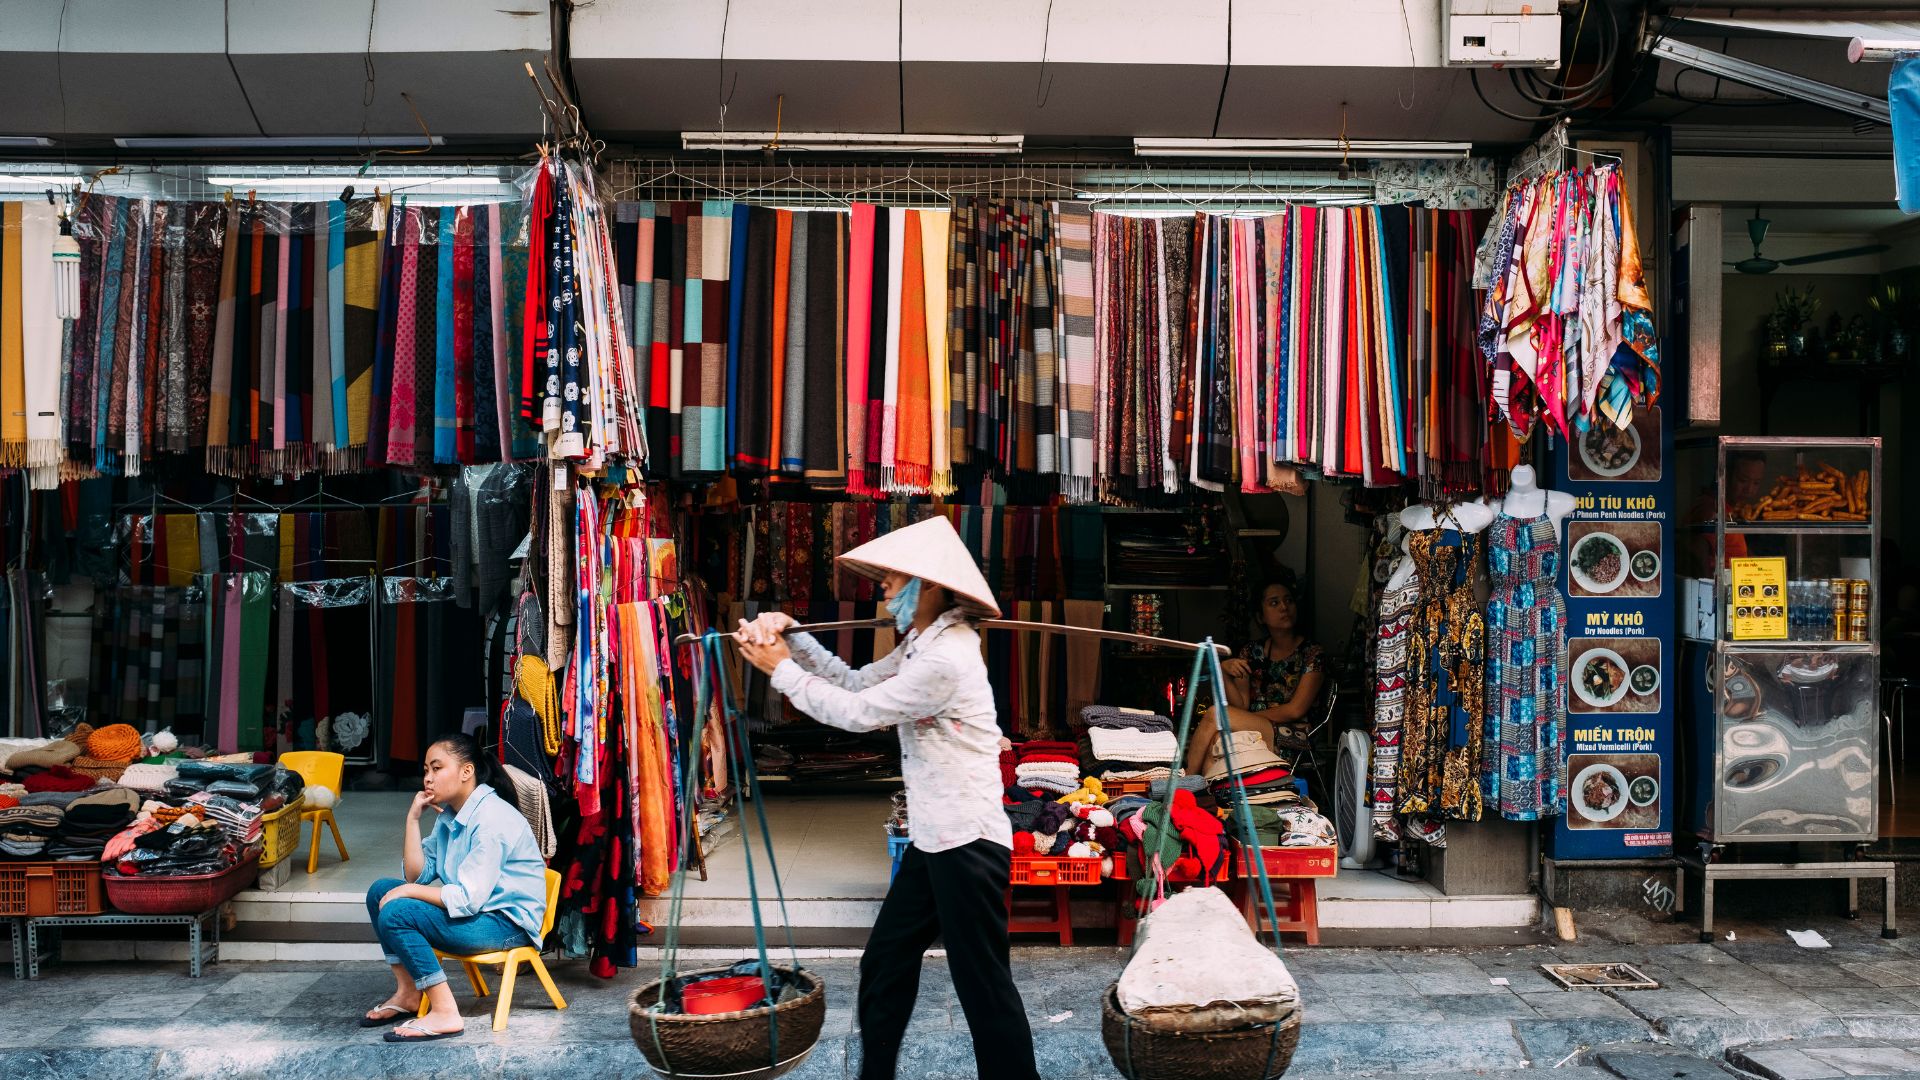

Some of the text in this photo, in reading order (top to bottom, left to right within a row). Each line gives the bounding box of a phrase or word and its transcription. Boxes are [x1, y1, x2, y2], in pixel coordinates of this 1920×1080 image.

[1599, 494, 1622, 509] TÍU
[1626, 494, 1656, 509] KHÔ
[1576, 511, 1599, 519] Phnom
[1600, 511, 1617, 519] Penh
[1618, 511, 1645, 519] Noodles
[1646, 511, 1666, 519] (Pork)
[1614, 611, 1643, 625] KHÔ
[1585, 627, 1645, 635] Dry Noodles (Pork)
[1617, 726, 1655, 744] TRỘN
[1576, 743, 1653, 751] Mixed Vermicelli (Pork)
